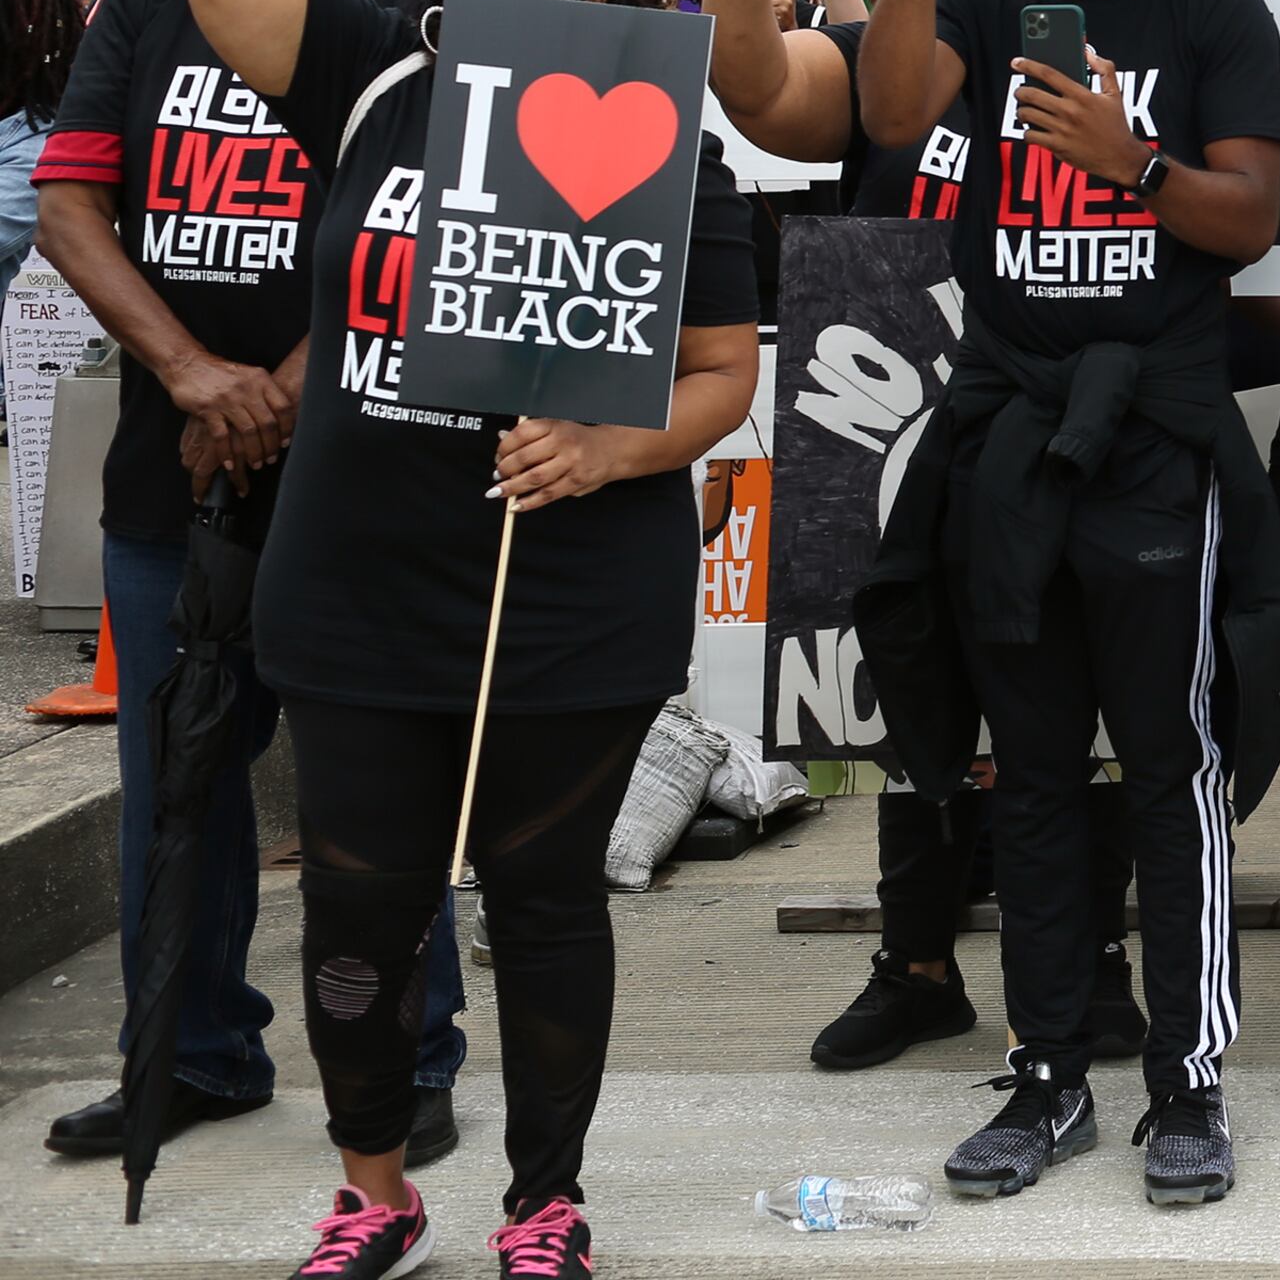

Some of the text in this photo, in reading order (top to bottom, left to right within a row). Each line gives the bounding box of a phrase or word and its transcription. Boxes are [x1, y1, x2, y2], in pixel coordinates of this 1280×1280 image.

[145, 128, 311, 218] LIVES
[440, 63, 513, 214] I
[432, 220, 663, 297] BEING
[20, 303, 62, 321] FEAR
[424, 281, 659, 357] BLACK
